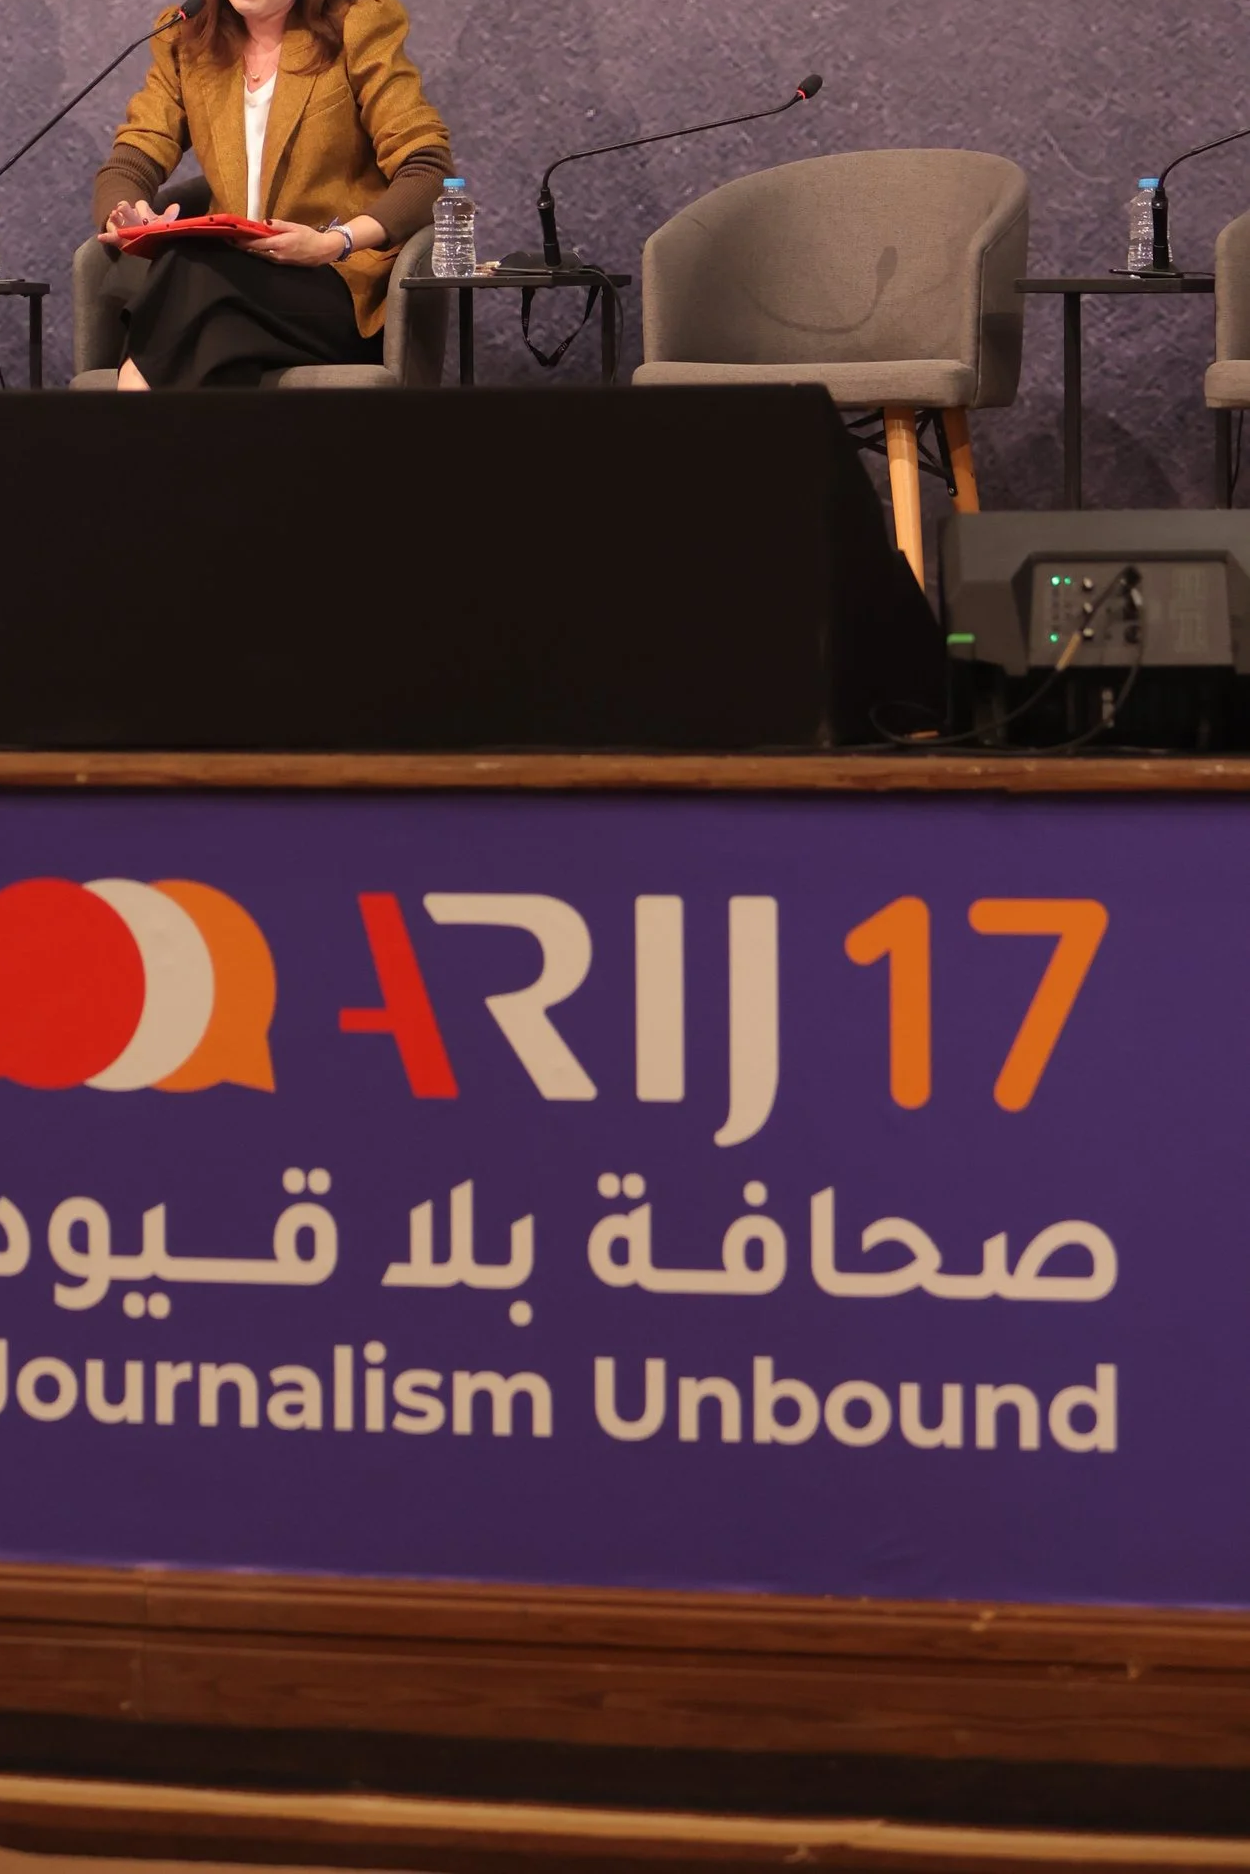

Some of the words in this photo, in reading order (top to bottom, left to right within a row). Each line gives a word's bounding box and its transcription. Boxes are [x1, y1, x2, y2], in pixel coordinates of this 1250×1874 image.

[338, 892, 779, 1147] ARIJ
[844, 896, 1108, 1112] 17
[381, 1180, 534, 1326] بلا
[587, 1173, 1118, 1303] صحافة
[594, 1356, 1117, 1452] Unbound
